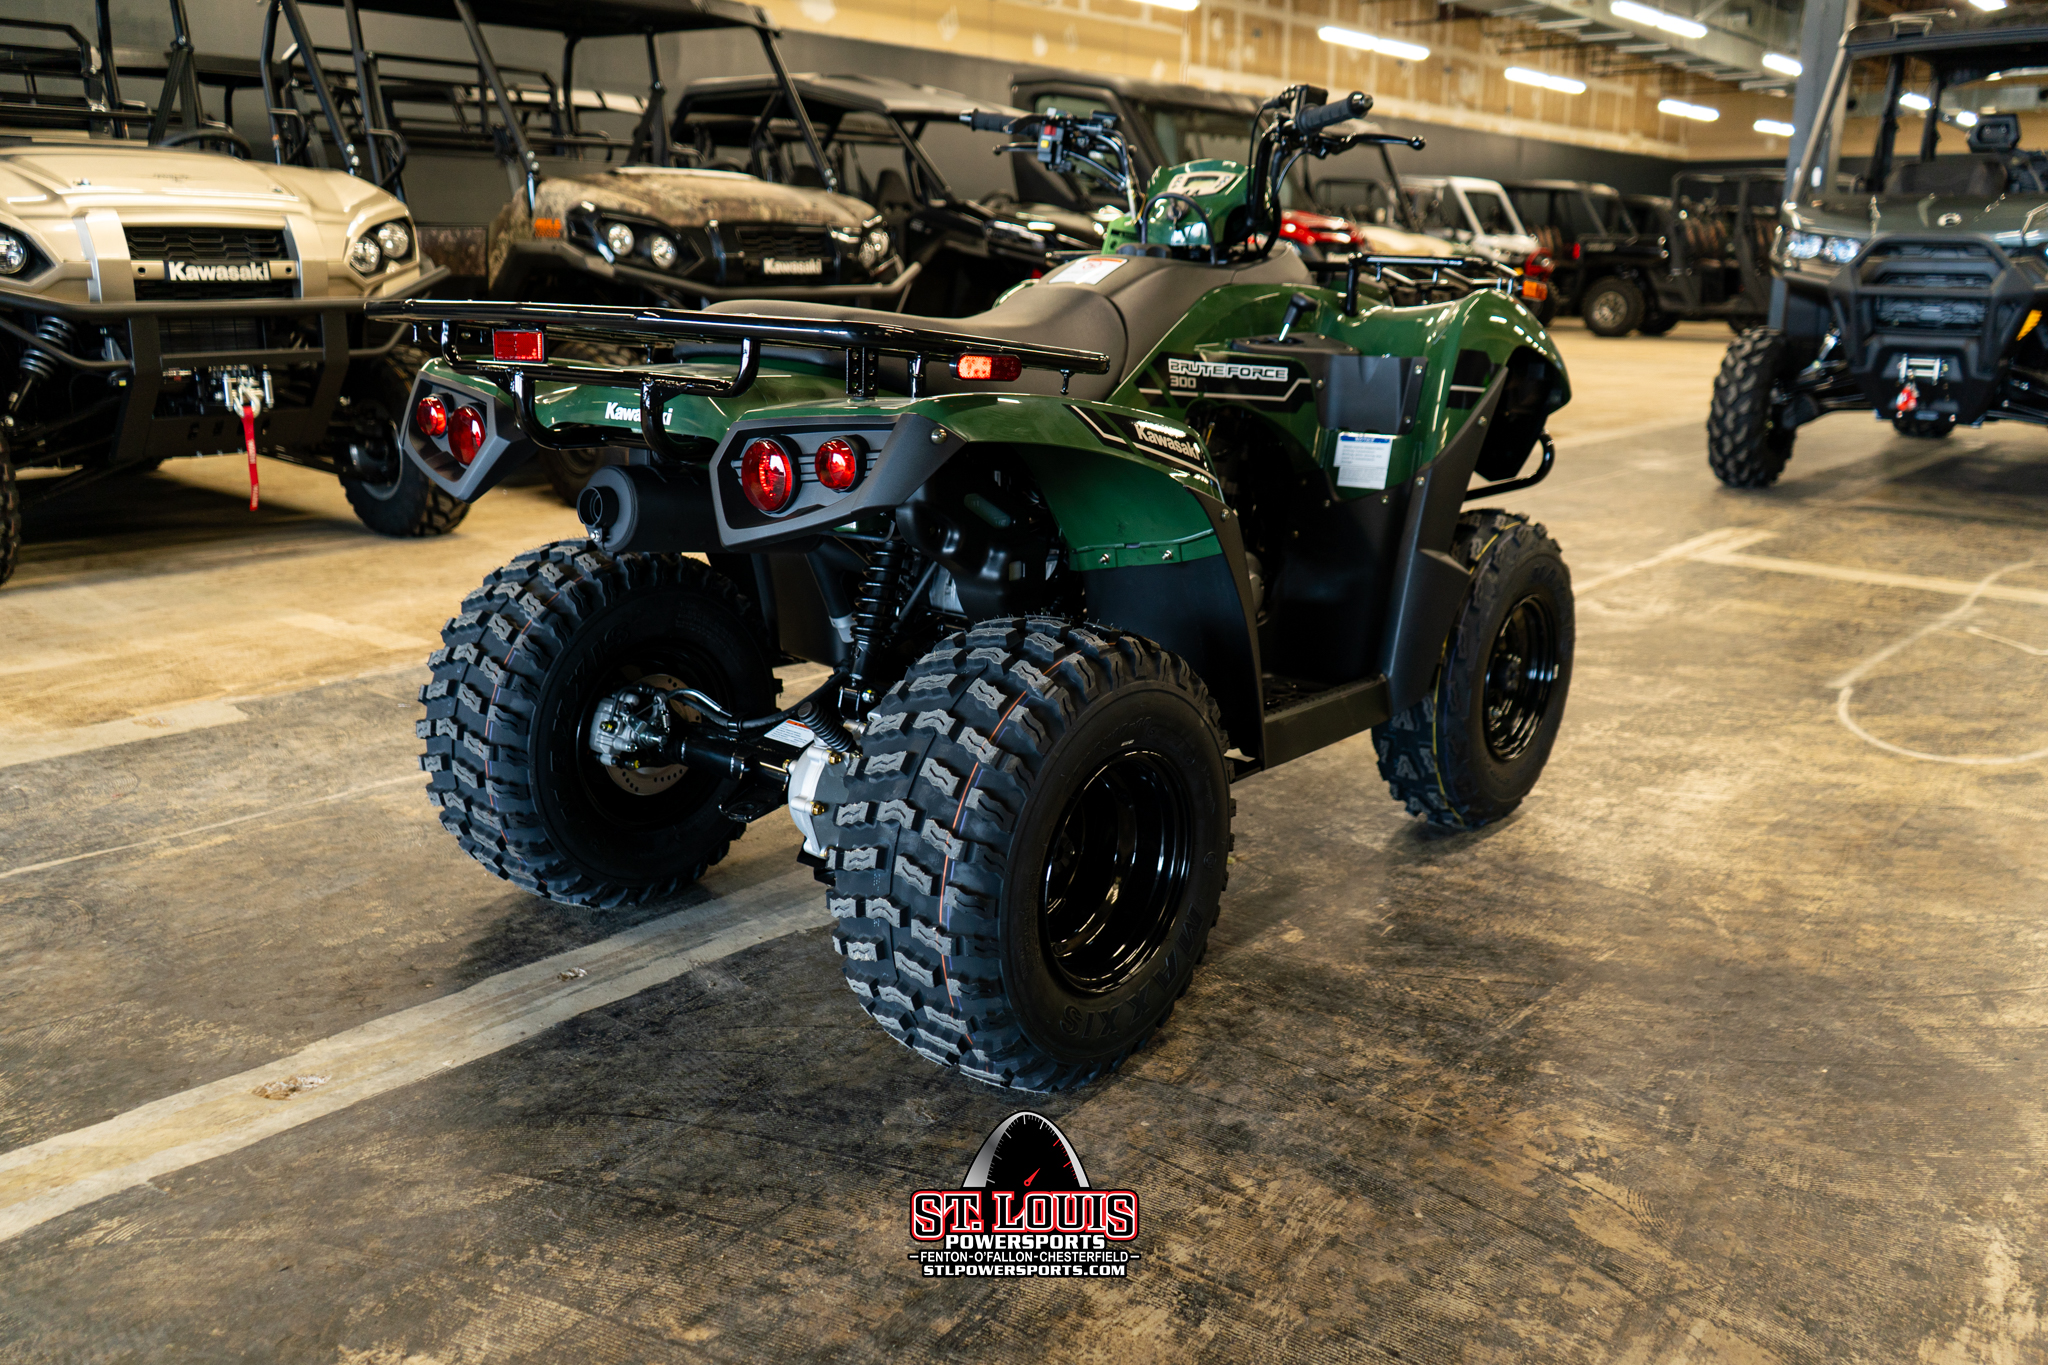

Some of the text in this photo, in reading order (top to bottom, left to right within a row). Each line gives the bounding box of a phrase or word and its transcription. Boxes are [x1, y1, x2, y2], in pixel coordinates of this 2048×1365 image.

[168, 261, 270, 281] Kawasaki
[763, 257, 823, 275] Kawasaki
[1170, 375, 1197, 389] 300
[604, 401, 674, 426] Kawaki
[1134, 422, 1201, 461] Kawasaki
[1060, 902, 1204, 1040] MAXXIS
